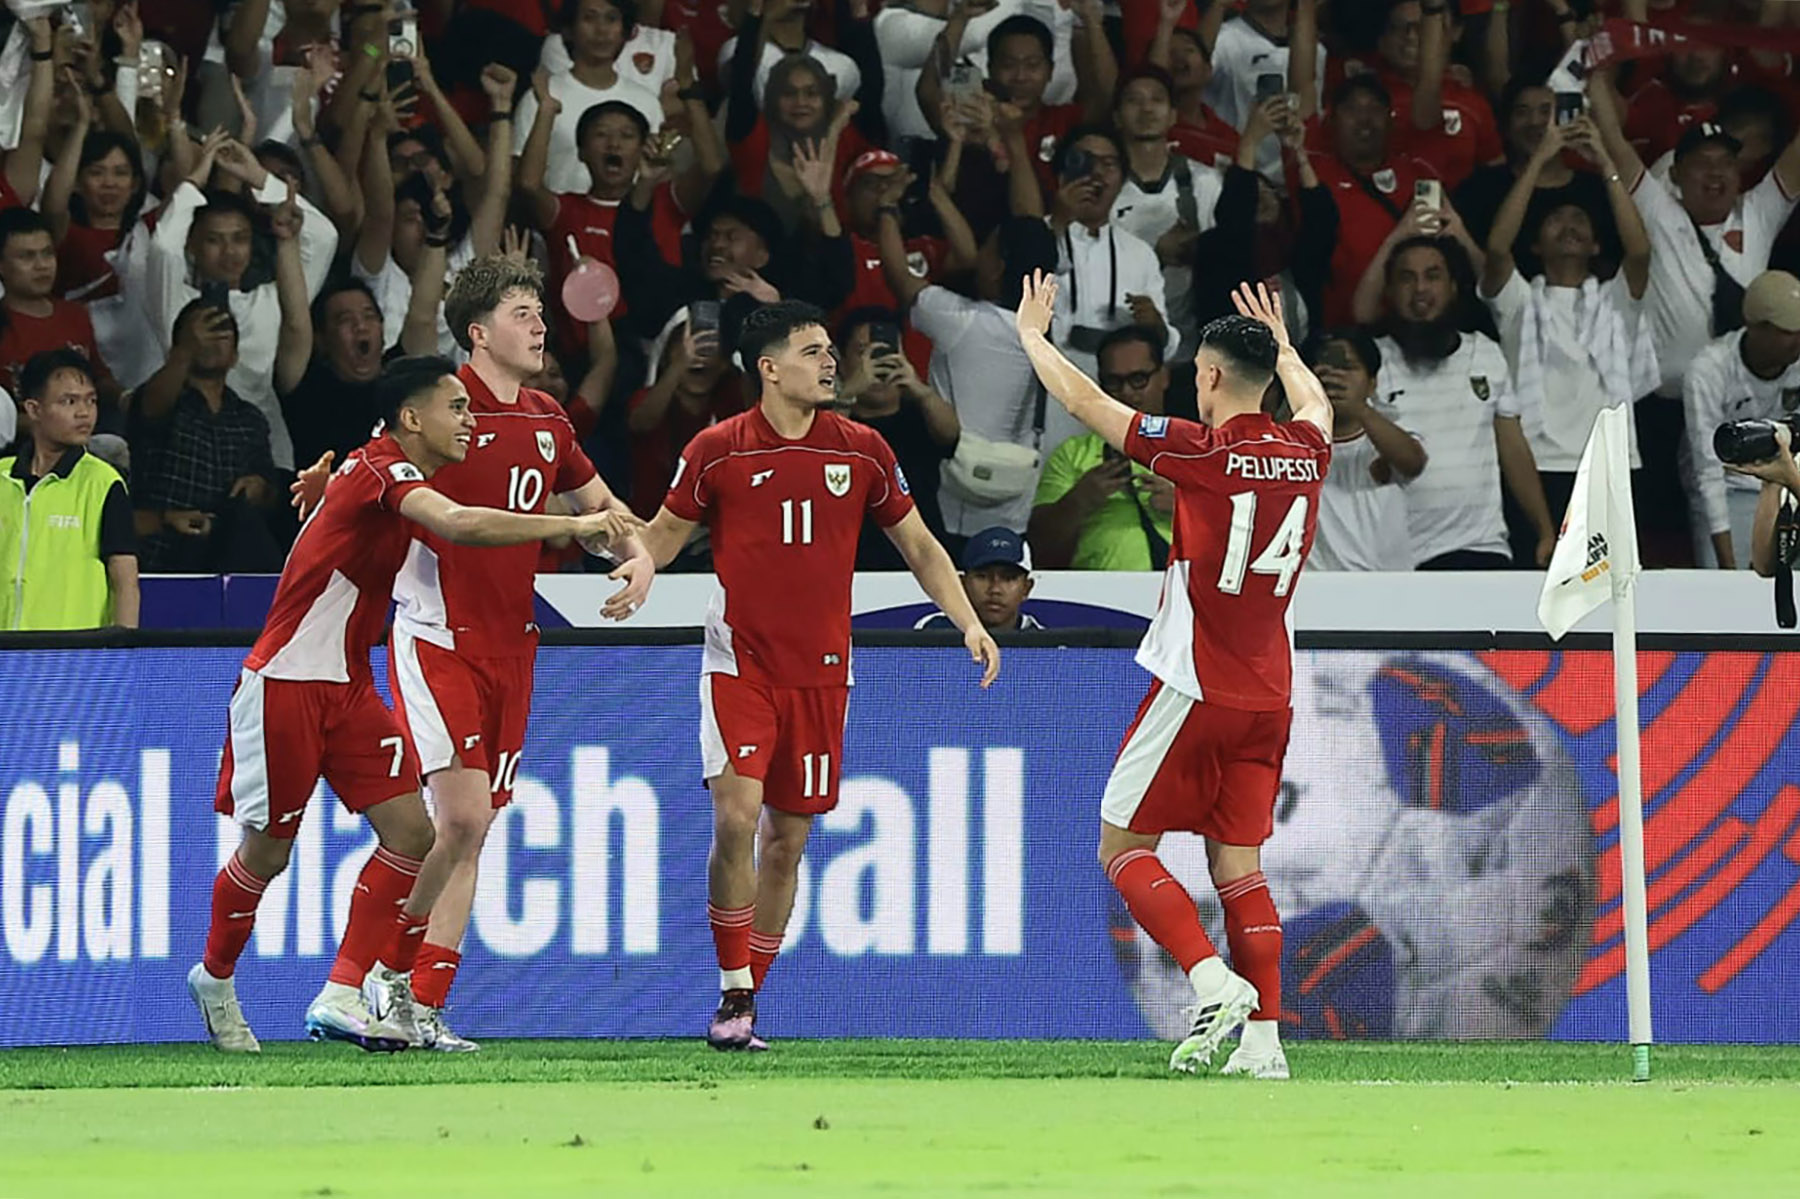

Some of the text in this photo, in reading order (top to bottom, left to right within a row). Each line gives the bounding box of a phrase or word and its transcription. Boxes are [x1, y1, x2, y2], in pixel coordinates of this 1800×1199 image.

[507, 465, 544, 512] 10
[780, 499, 813, 545] 11
[1216, 490, 1309, 598] 14
[380, 735, 404, 778] 7
[802, 752, 830, 798] 11
[2, 741, 1025, 963] cial Mch all
